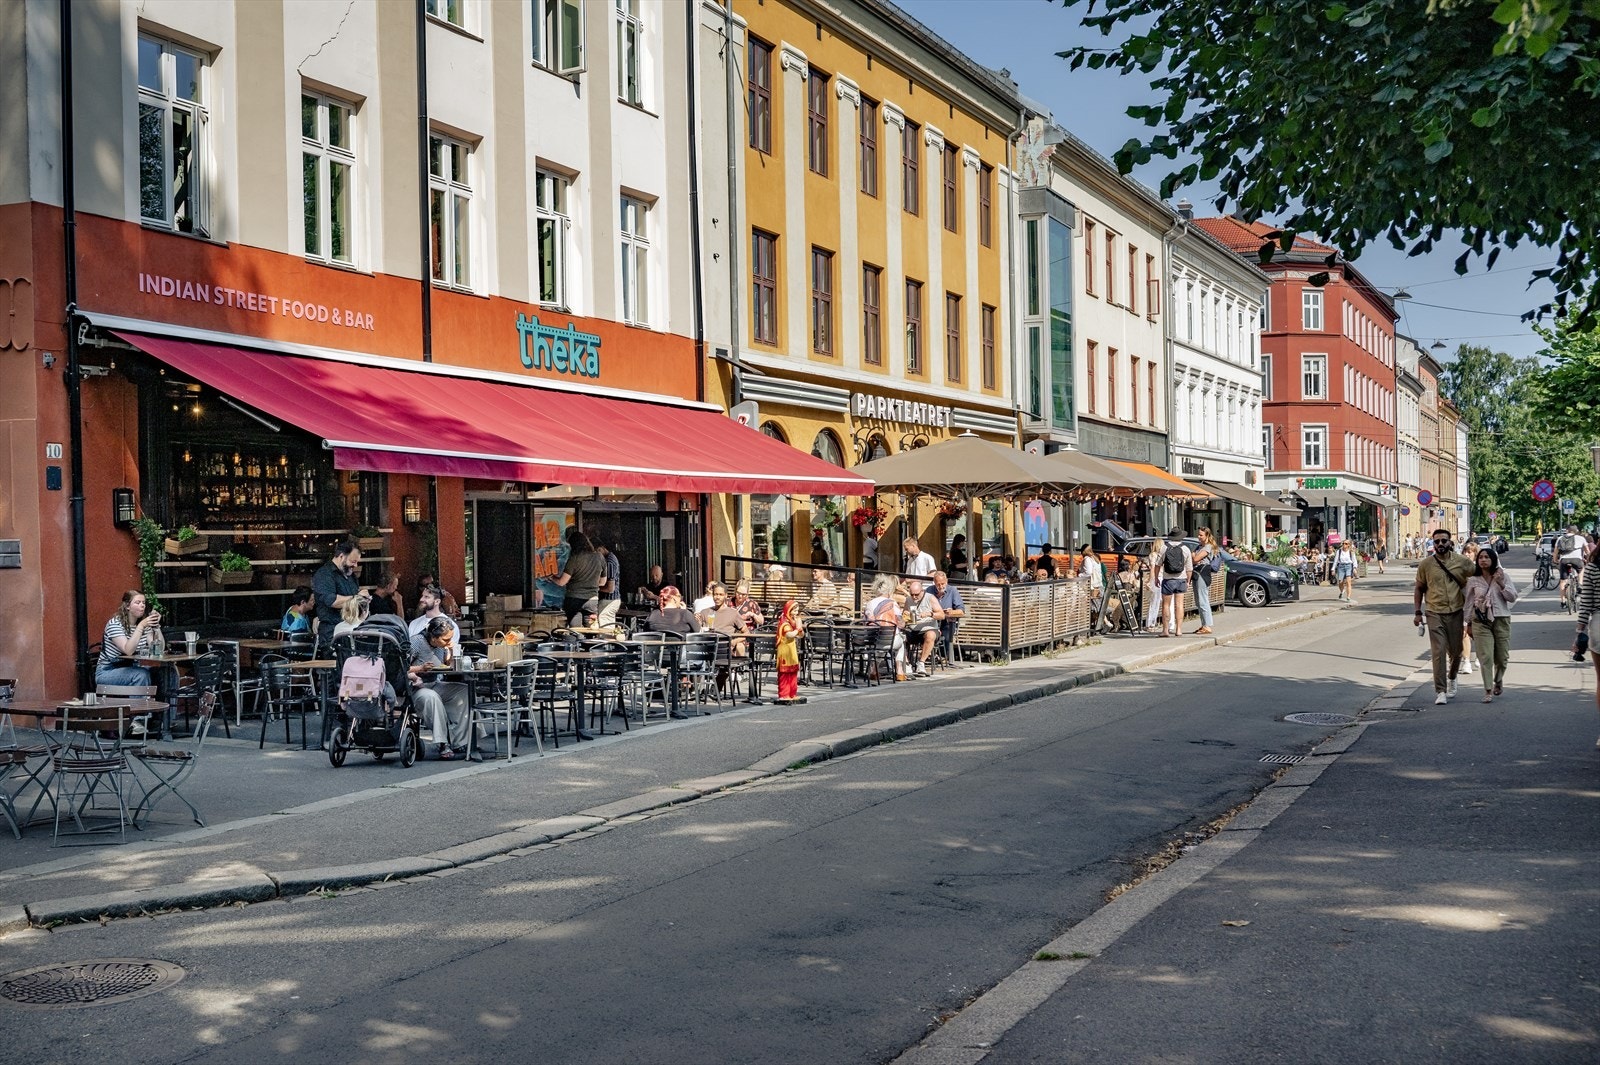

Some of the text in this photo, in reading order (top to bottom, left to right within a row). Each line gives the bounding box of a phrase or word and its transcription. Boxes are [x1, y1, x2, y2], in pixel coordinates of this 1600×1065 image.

[139, 273, 374, 331] INDIAN STREET FOOD & BAR
[516, 313, 601, 378] theka
[856, 392, 952, 428] PARKTEATRET
[47, 444, 61, 458] 10
